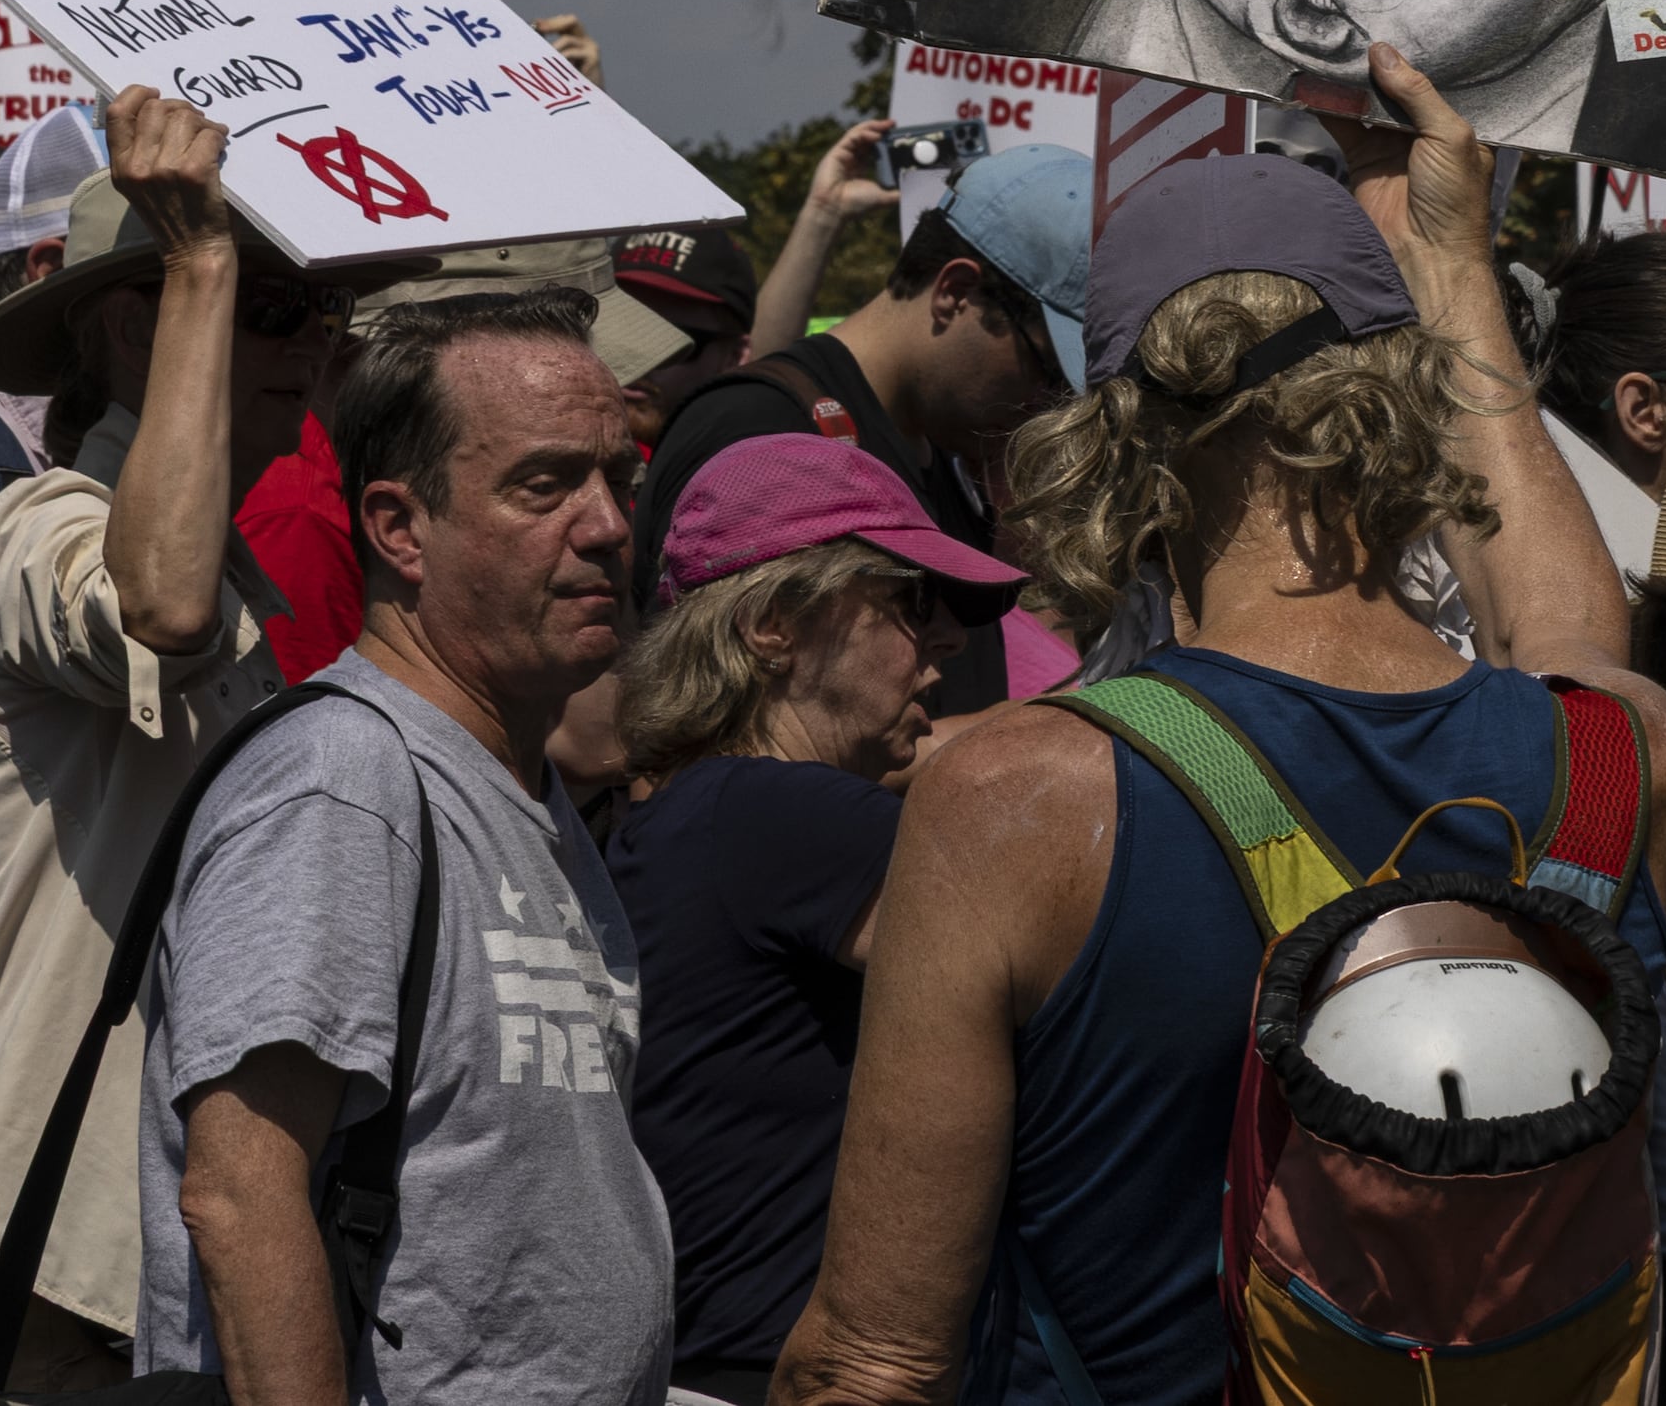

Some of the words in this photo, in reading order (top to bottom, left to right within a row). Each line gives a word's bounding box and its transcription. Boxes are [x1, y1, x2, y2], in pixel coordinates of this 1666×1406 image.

[29, 64, 73, 85] the
[174, 55, 303, 108] GUARD
[989, 97, 1034, 131] DC
[1439, 961, 1519, 975] thousand
[499, 1015, 617, 1093] FRE
